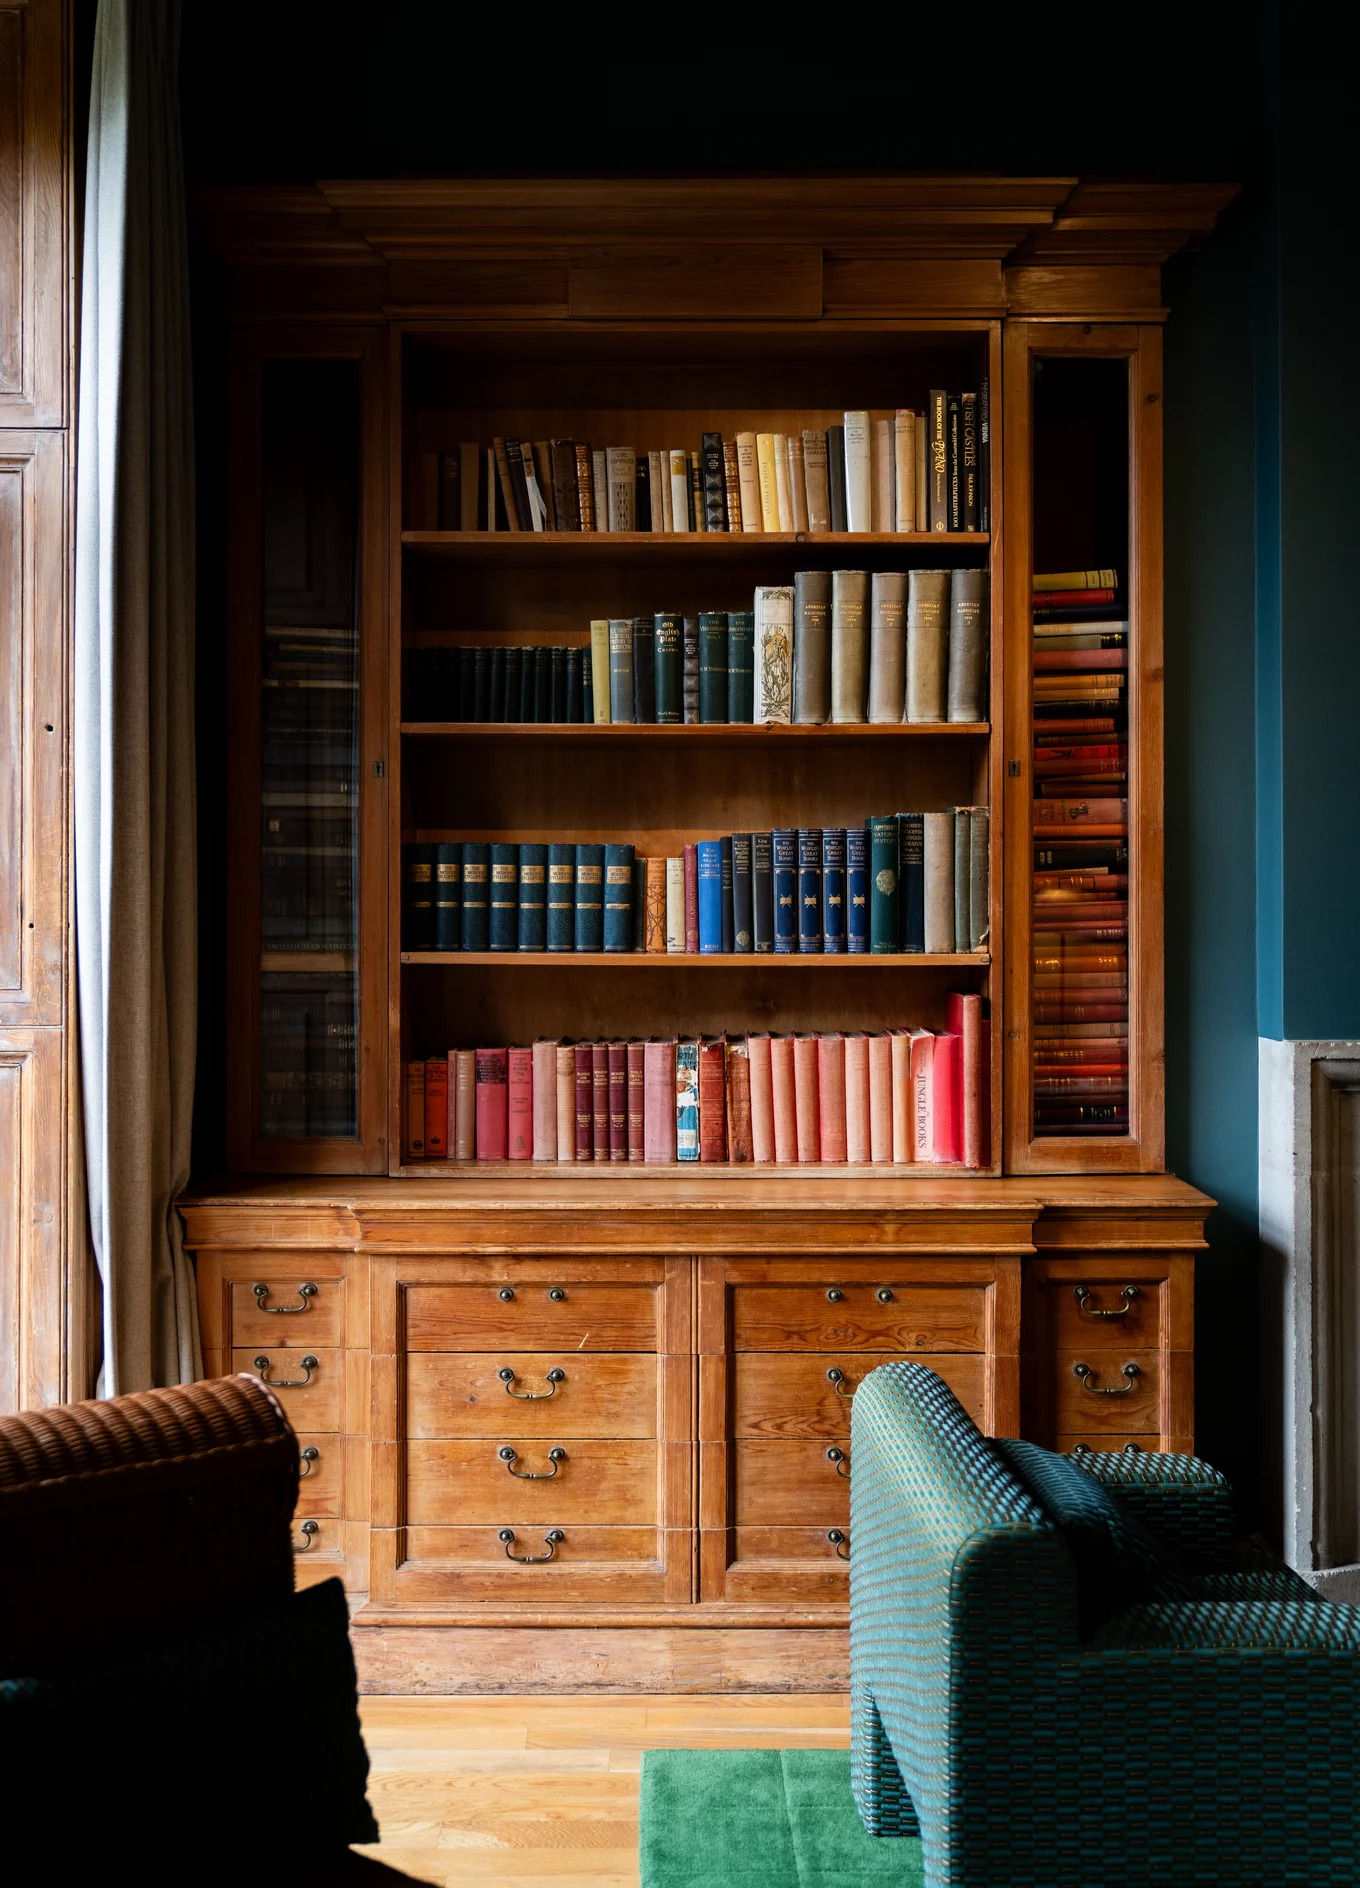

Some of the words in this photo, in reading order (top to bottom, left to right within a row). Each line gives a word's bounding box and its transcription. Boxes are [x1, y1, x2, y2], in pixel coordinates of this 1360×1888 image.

[932, 440, 946, 473] PIANO
[964, 428, 974, 466] CASTLES
[917, 1074, 927, 1113] JUNGLE
[917, 1115, 927, 1148] BOOKS
